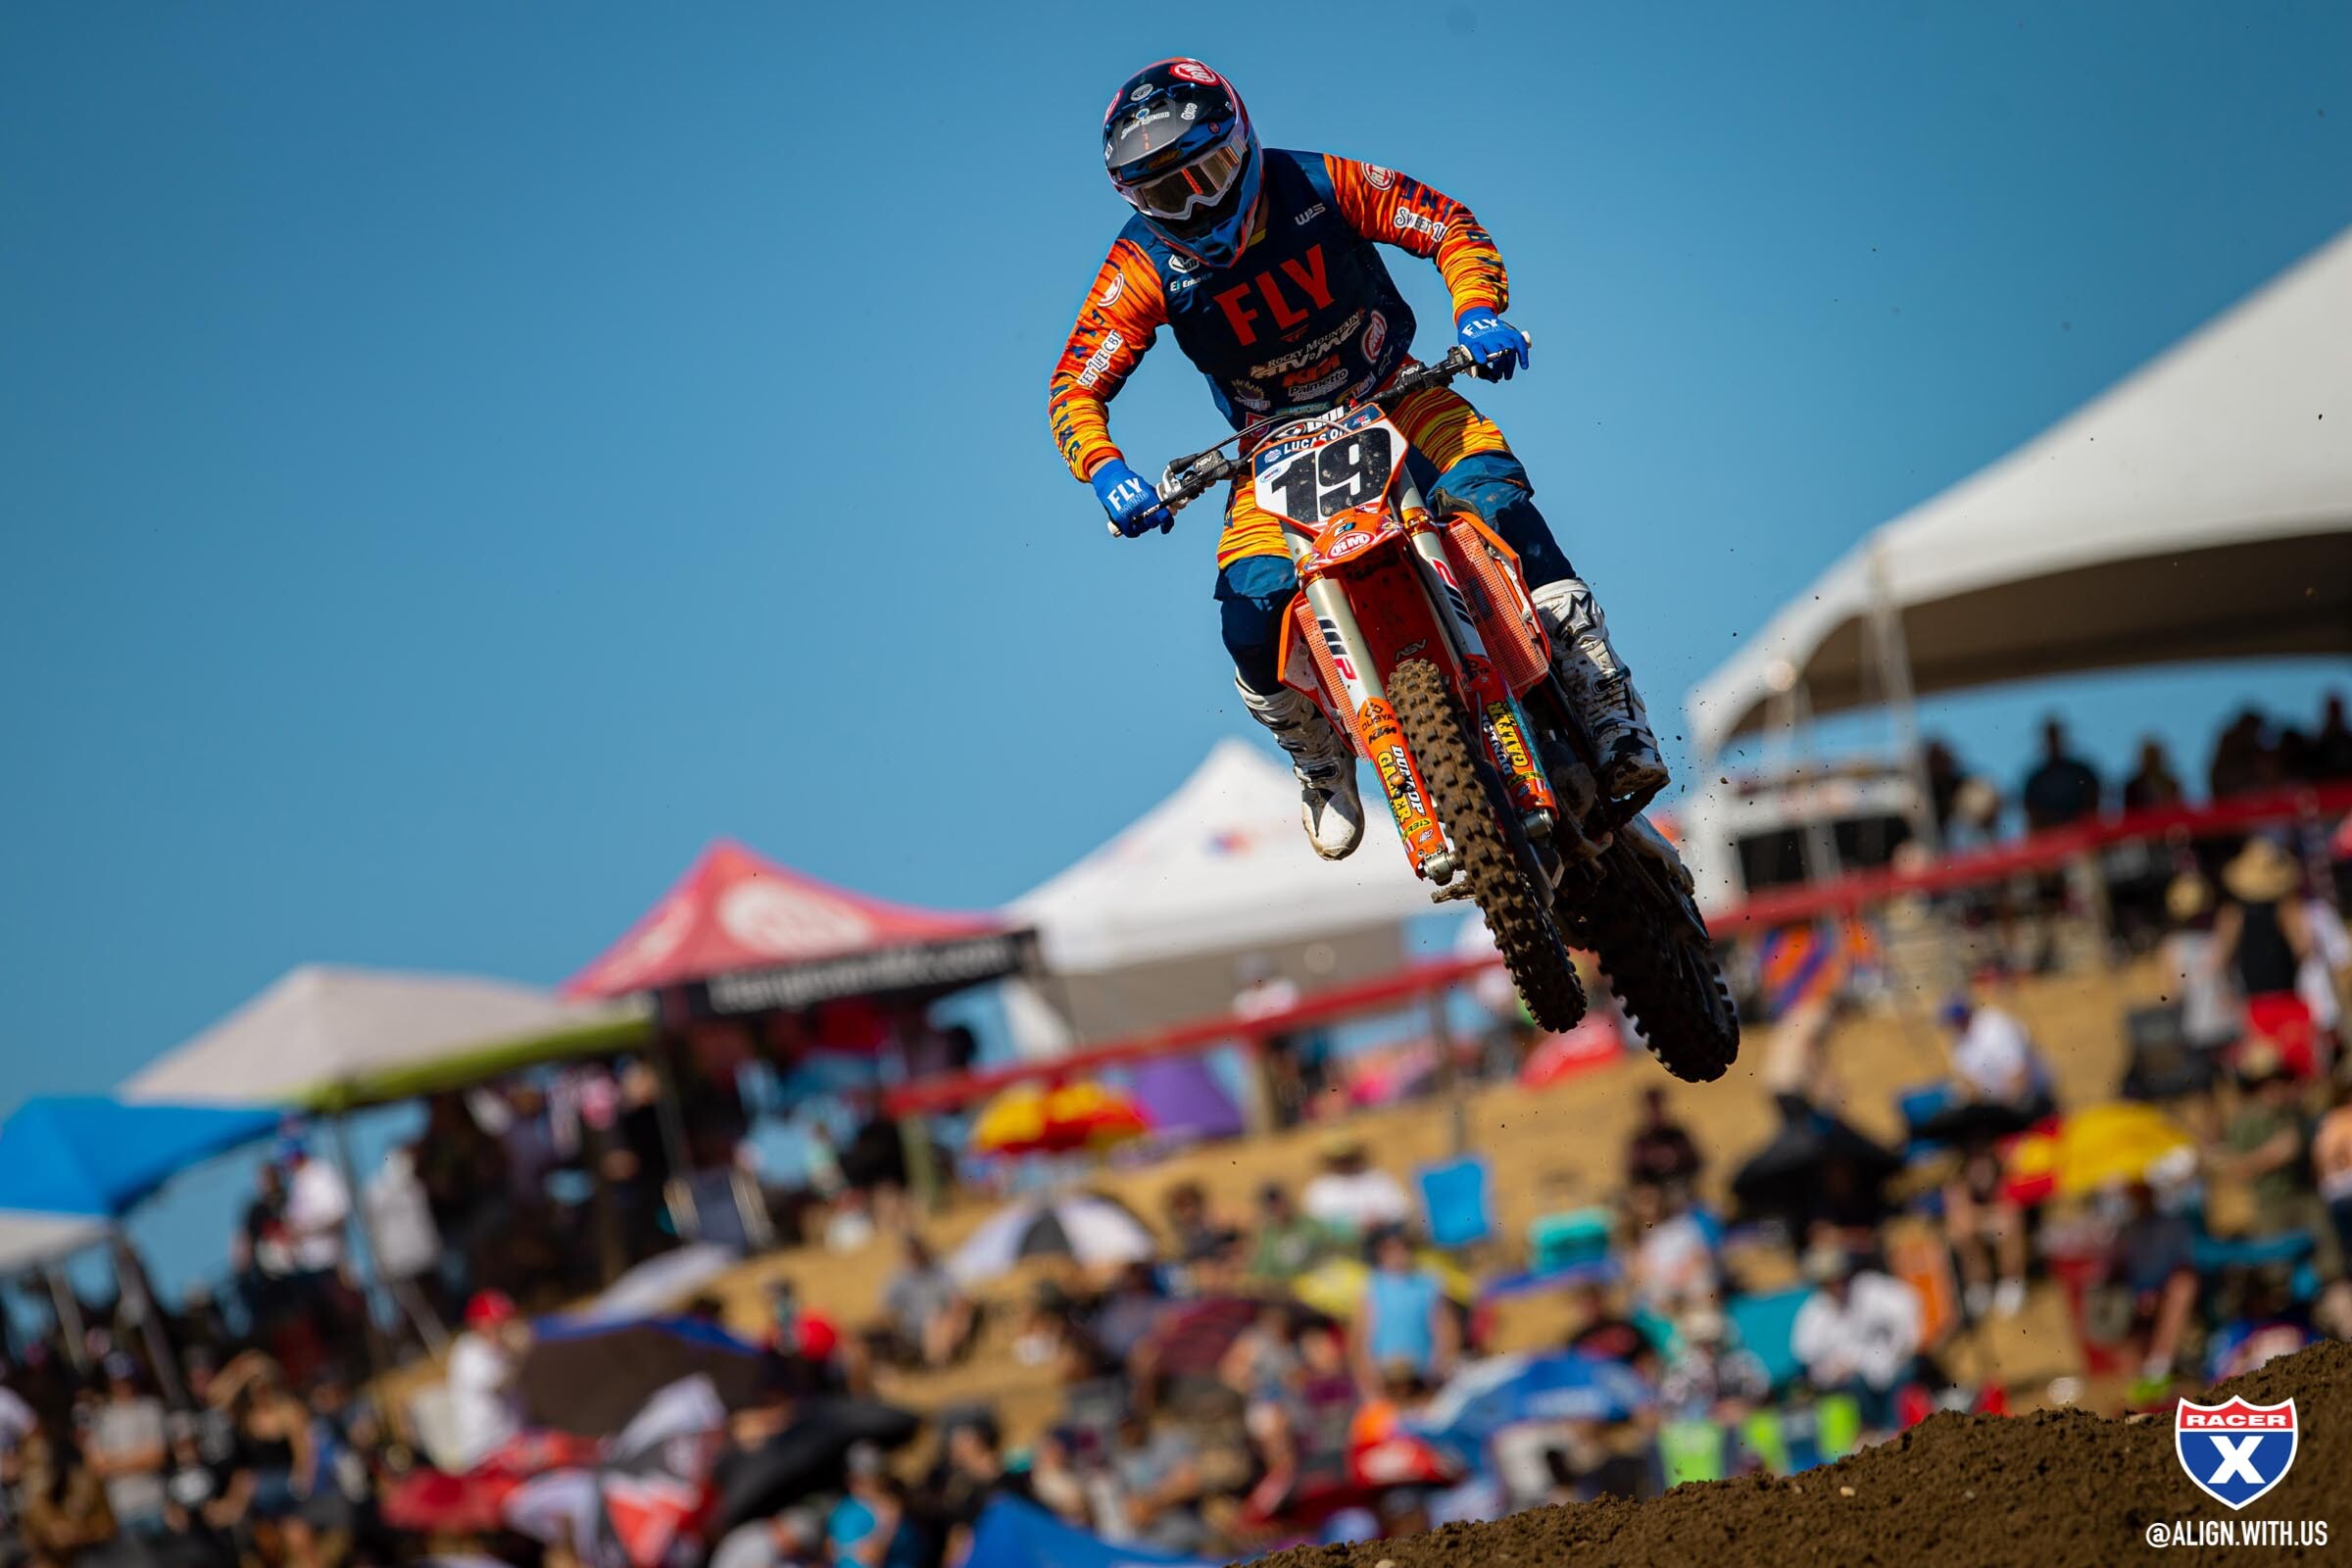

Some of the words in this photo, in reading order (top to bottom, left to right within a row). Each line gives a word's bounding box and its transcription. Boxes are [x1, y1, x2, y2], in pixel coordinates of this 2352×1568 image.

[1212, 243, 1335, 346] FLY
[1267, 348, 1304, 368] ROCKY
[1305, 311, 1360, 352] MOUNTAIN
[1461, 318, 1499, 337] FLY
[1289, 369, 1347, 394] Palmetto
[1107, 477, 1144, 512] FLY
[1271, 427, 1392, 523] 19
